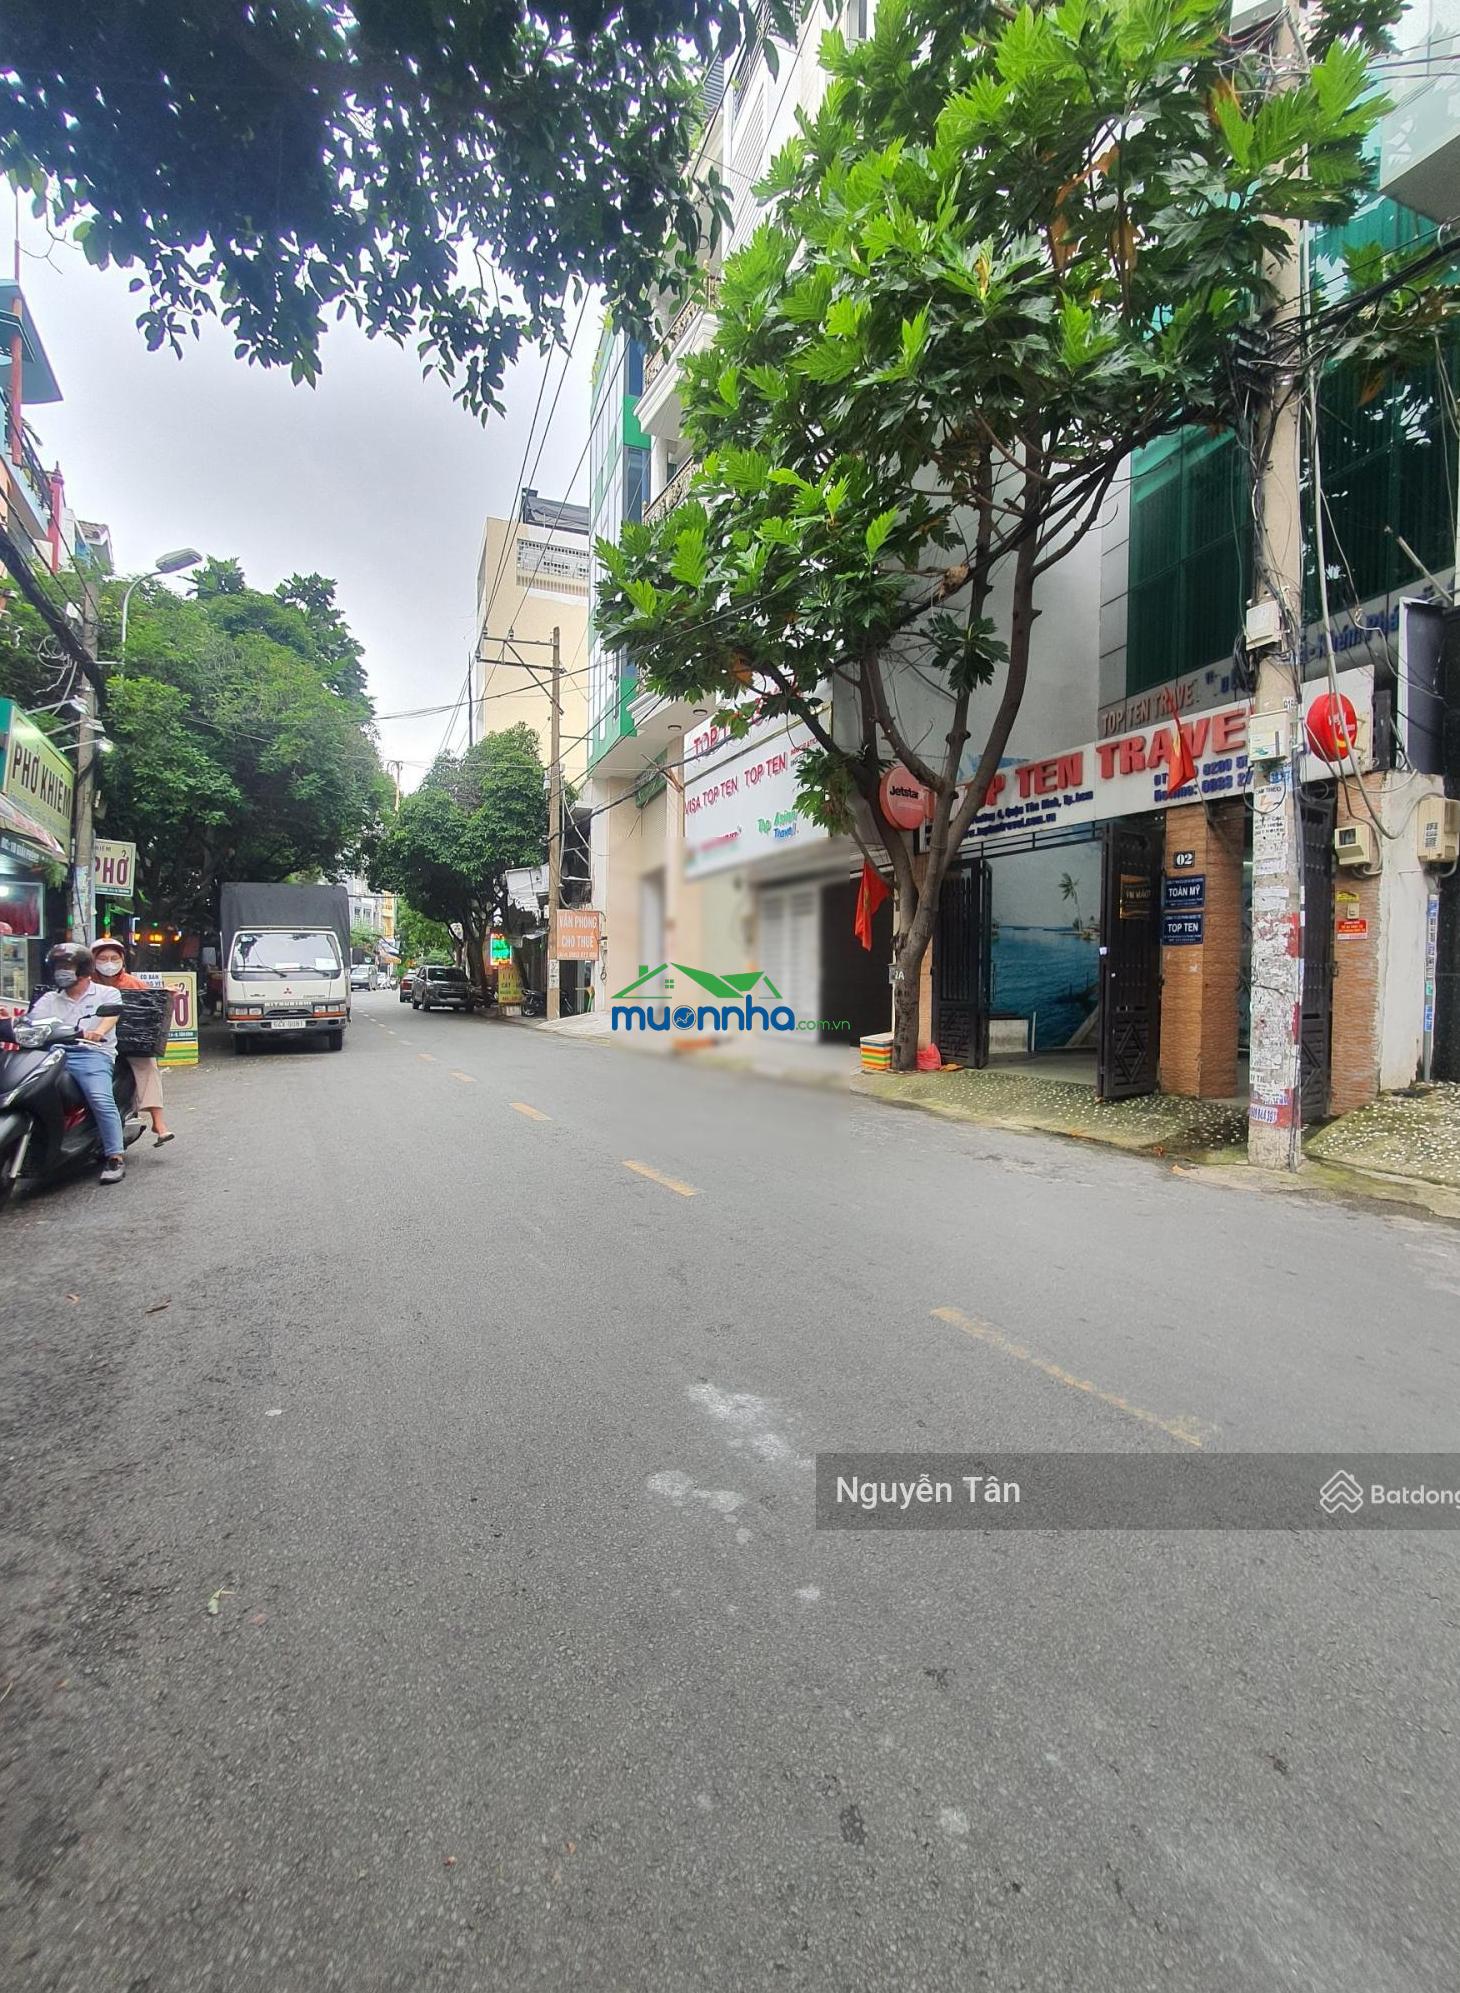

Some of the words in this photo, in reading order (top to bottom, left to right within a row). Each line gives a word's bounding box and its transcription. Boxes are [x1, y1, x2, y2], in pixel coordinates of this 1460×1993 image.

[1102, 708, 1124, 736] TOP
[1126, 699, 1150, 728] TEN
[702, 786, 719, 806] TOP
[720, 776, 739, 798] TEN
[744, 764, 765, 786] TOP
[765, 752, 788, 778] TEN
[1015, 751, 1083, 798] TEN
[1176, 853, 1193, 865] 02
[1168, 885, 1188, 898] TOÀN
[1168, 923, 1182, 933] TOP
[1184, 922, 1199, 932] TEN
